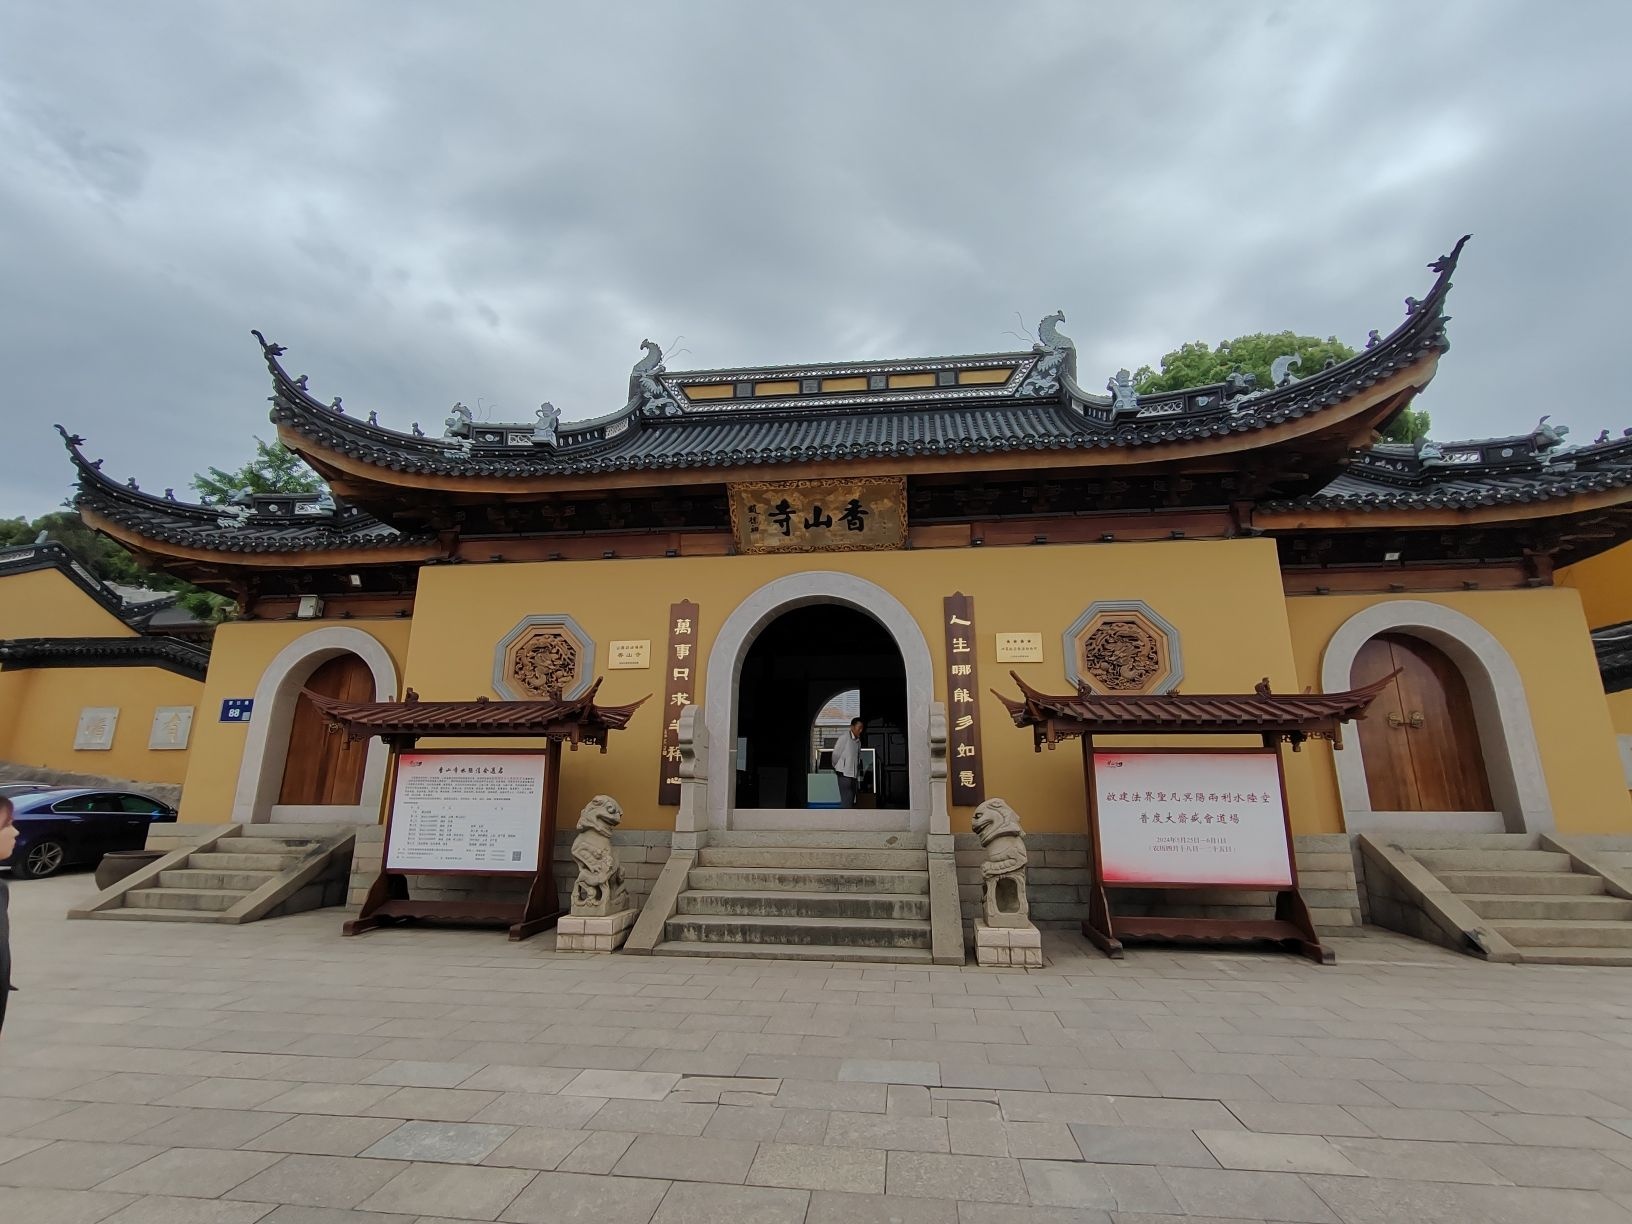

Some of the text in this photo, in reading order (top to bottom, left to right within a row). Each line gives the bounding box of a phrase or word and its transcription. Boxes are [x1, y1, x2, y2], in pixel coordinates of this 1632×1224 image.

[768, 498, 869, 537] 香山寺
[228, 708, 240, 717] 88
[950, 615, 977, 788] 人生哪能多如意
